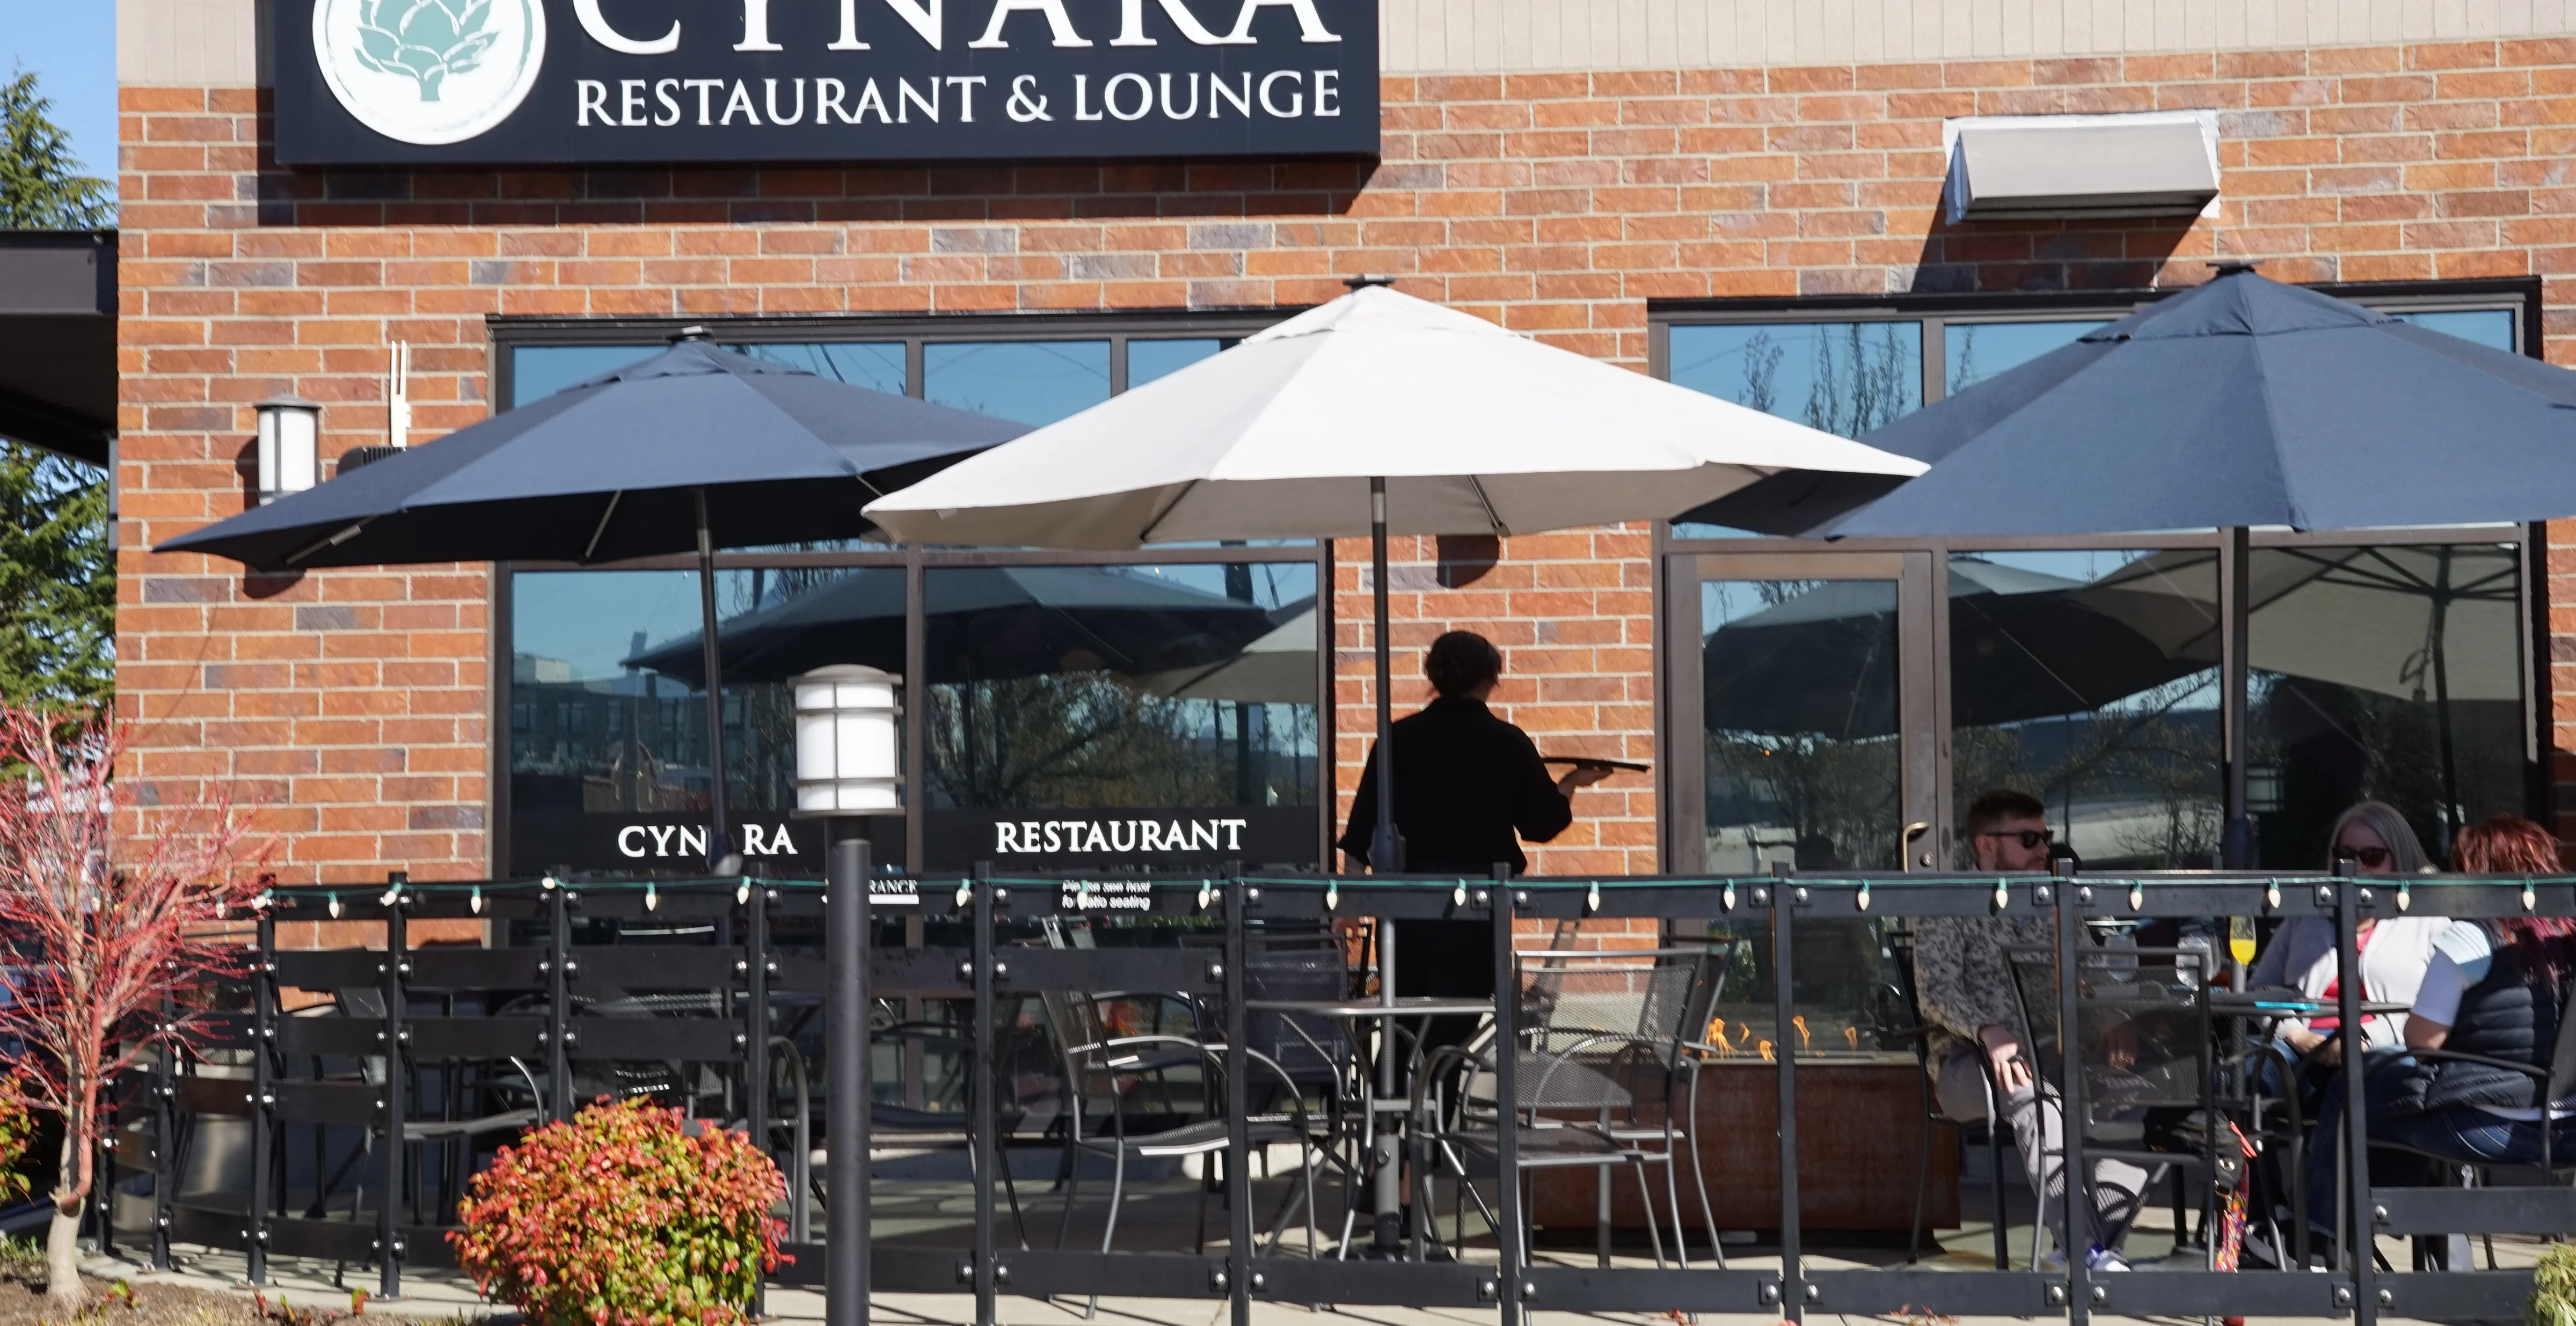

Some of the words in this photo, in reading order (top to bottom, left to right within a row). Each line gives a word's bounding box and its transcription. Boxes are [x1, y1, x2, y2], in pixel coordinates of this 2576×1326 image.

[577, 76, 987, 127] RESTAURANT
[1006, 75, 1054, 122] &
[1074, 70, 1341, 122] LOUNGE
[618, 823, 799, 858] CYNRA
[995, 819, 1247, 853] RESTAURANT
[1062, 879, 1101, 893] Plese
[1102, 882, 1124, 893] see
[1086, 894, 1107, 909] atio
[1109, 894, 1151, 911] seating
